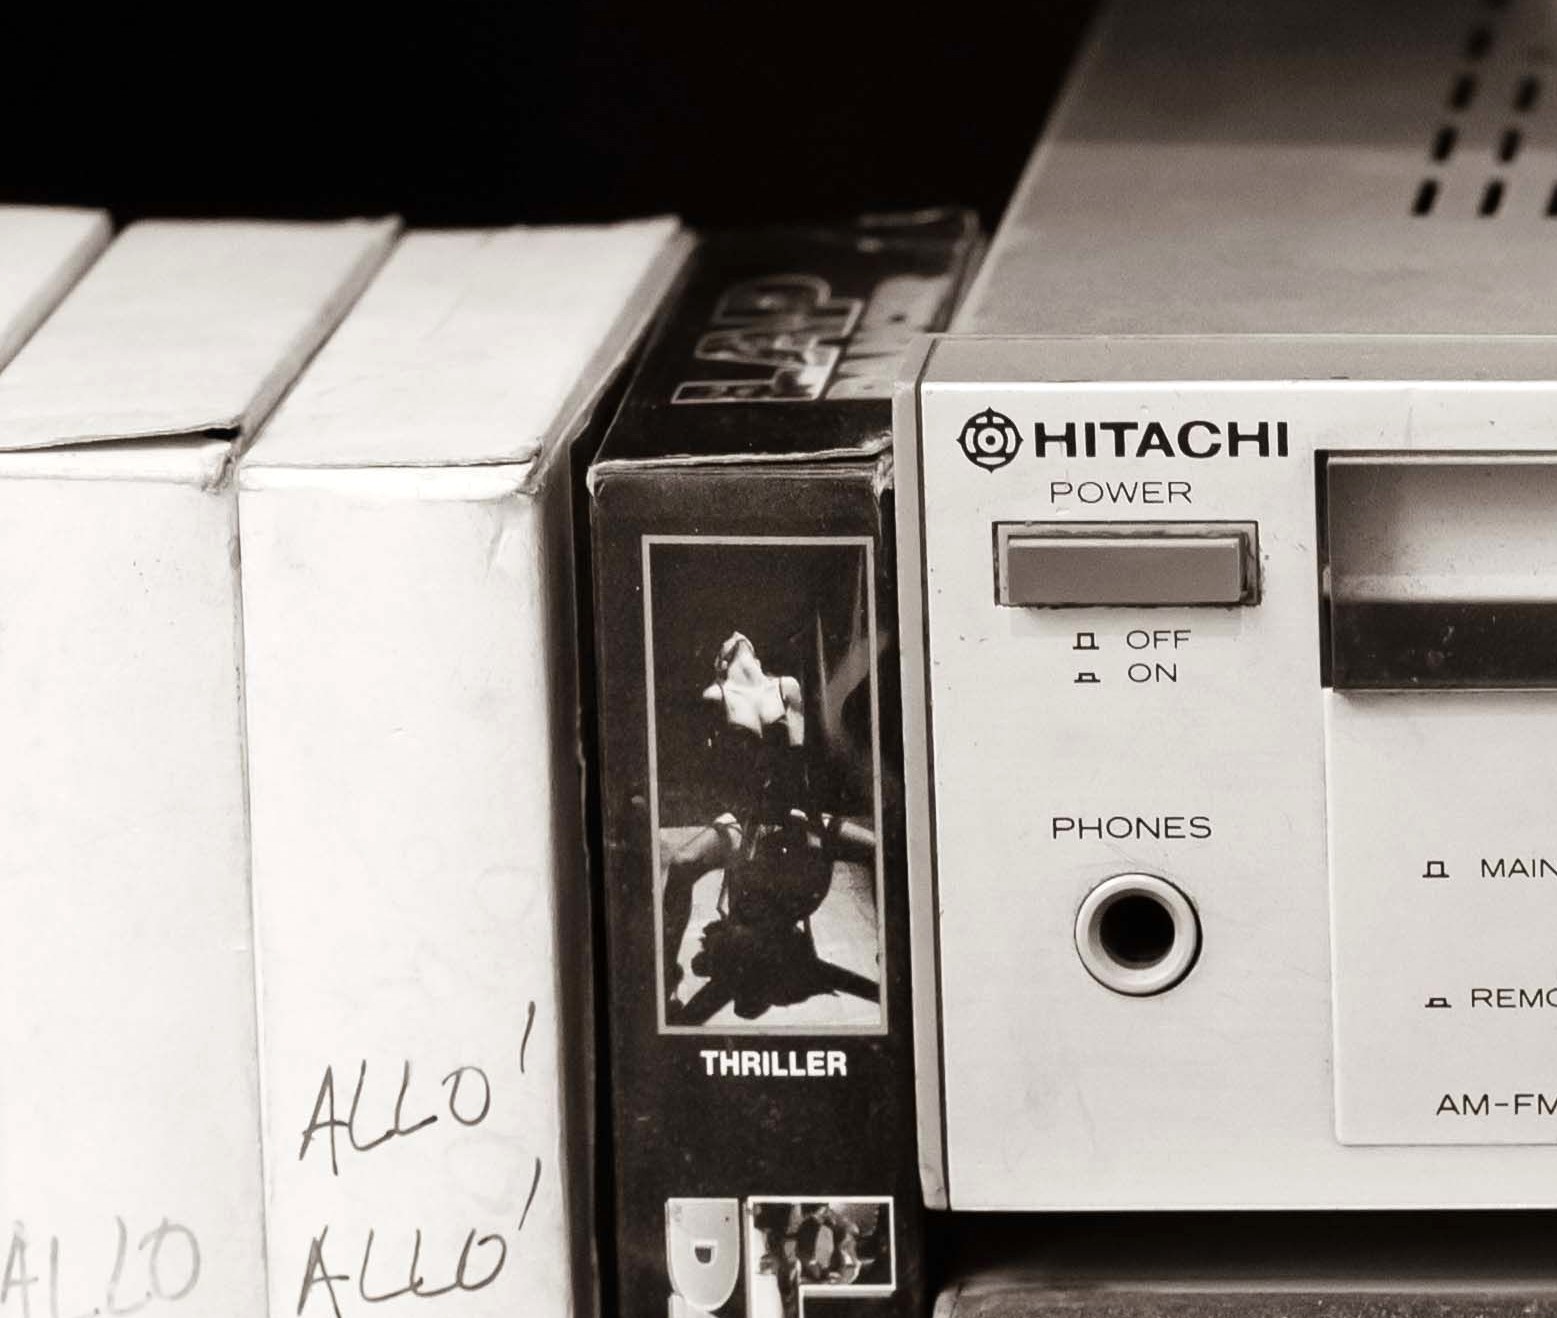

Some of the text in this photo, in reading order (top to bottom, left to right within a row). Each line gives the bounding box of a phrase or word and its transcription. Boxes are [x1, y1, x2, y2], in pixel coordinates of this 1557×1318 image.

[1034, 420, 1289, 459] HITACHI
[1050, 481, 1192, 504] POWER
[1126, 629, 1192, 650] OFF
[1127, 663, 1177, 683] ON
[1052, 816, 1212, 840] PHONES
[700, 1050, 847, 1077] THRILLER
